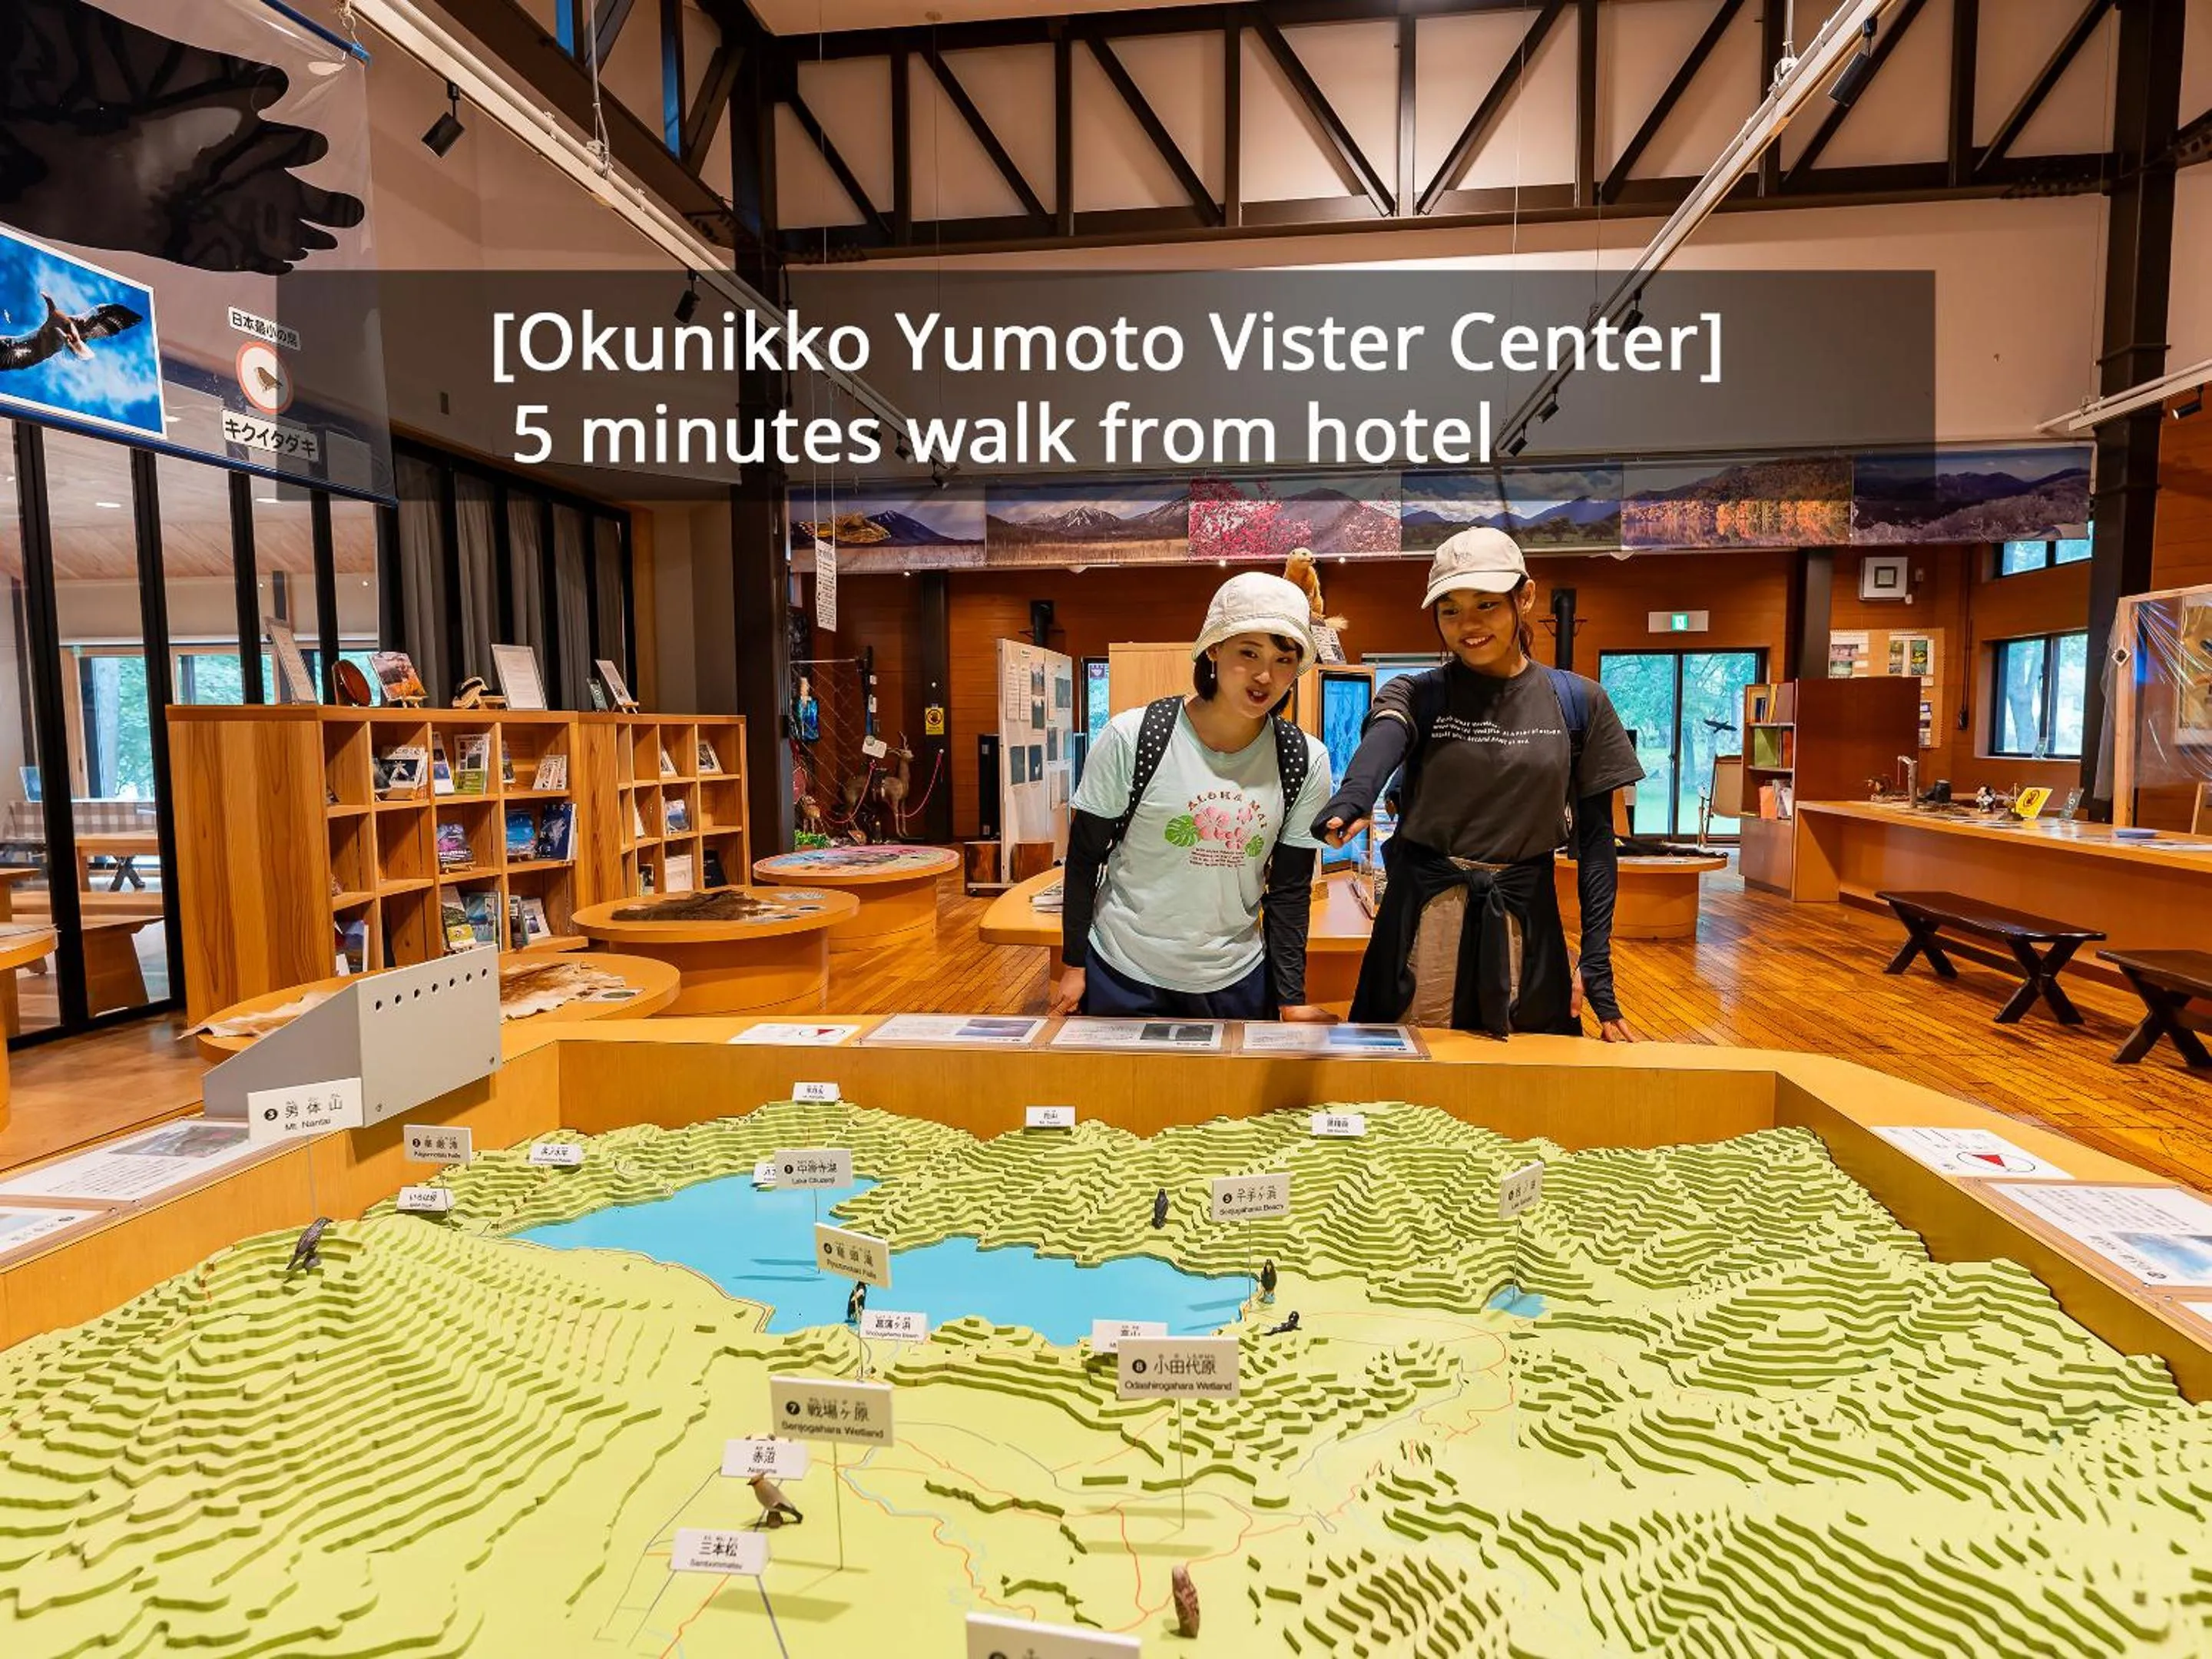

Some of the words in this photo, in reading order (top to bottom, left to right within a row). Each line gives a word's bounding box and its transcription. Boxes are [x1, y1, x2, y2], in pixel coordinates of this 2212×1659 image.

[225, 419, 316, 458] キクイタダキ
[1154, 1359, 1217, 1375] 小田代原
[1124, 1381, 1194, 1391] Odashirogahara
[1196, 1382, 1232, 1391] Wetland
[845, 1426, 884, 1439] Wetland
[698, 1541, 738, 1557] 三本松
